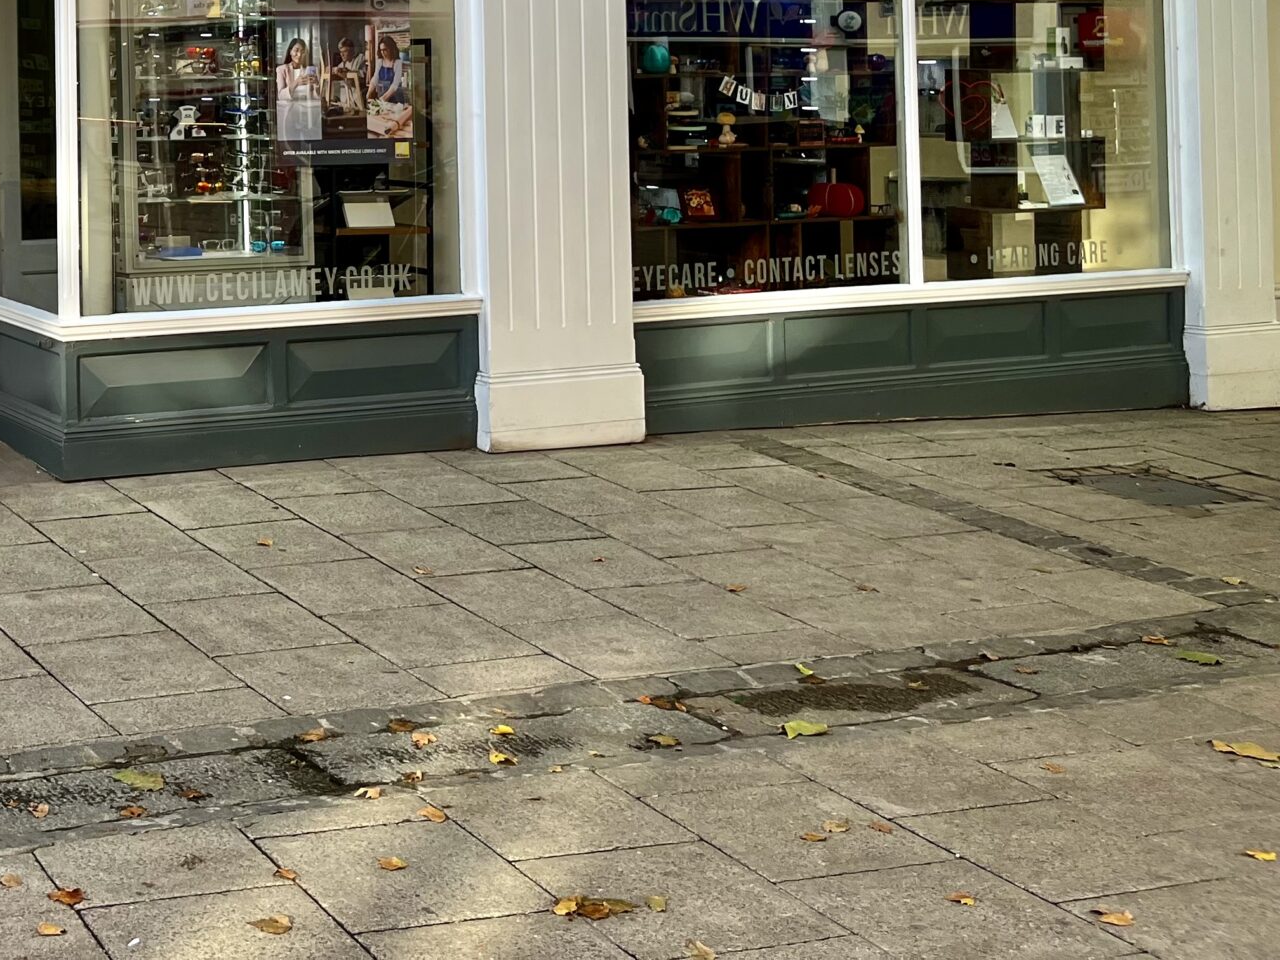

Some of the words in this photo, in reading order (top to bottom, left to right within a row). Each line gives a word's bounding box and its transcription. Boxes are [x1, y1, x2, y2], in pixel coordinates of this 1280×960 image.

[631, 260, 718, 291] EYECARE
[743, 254, 827, 285] CONTACT
[834, 249, 901, 280] LENSES
[986, 242, 1060, 270] HEARING
[1066, 240, 1109, 265] CARE
[132, 263, 413, 307] WWW.CECILAMEY.COUK
